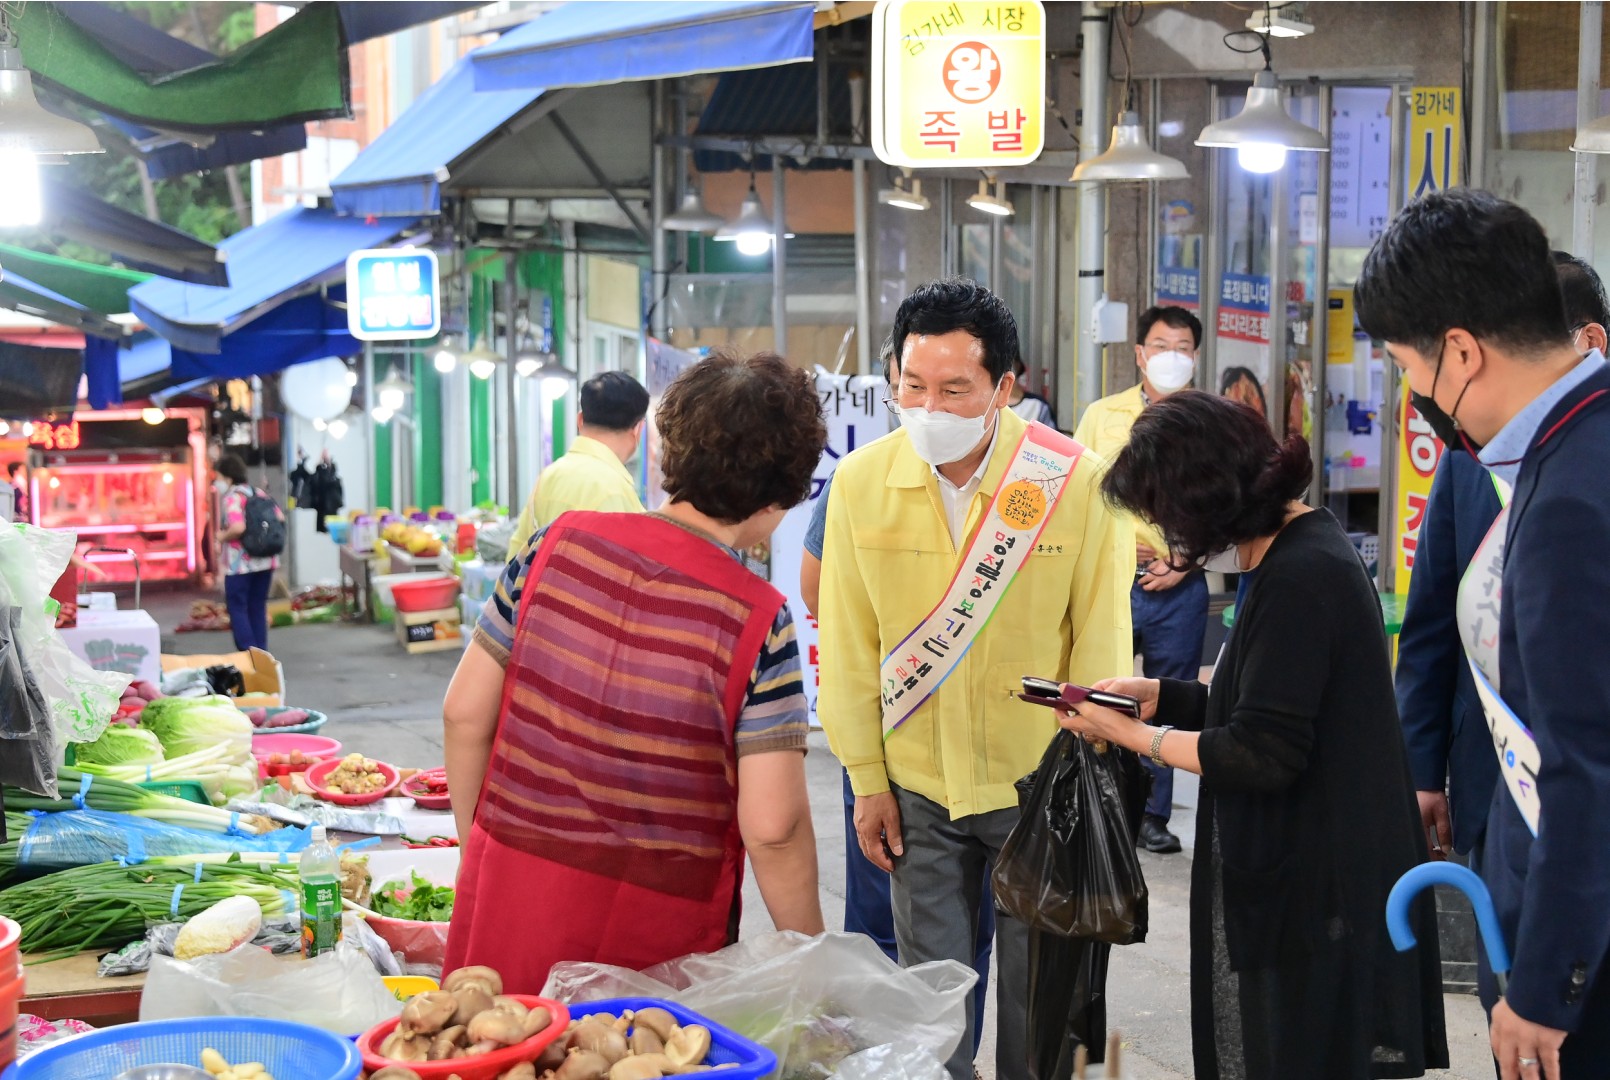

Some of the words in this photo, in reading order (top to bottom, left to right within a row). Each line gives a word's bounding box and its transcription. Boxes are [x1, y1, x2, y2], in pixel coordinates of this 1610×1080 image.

[901, 3, 964, 56] 김가네
[982, 7, 1025, 31] 시장
[947, 47, 998, 98] 왕
[1415, 91, 1455, 115] 김가네
[1222, 279, 1270, 304] 포장됩니다
[820, 386, 875, 417] 가네
[1040, 456, 1063, 472] 해운대
